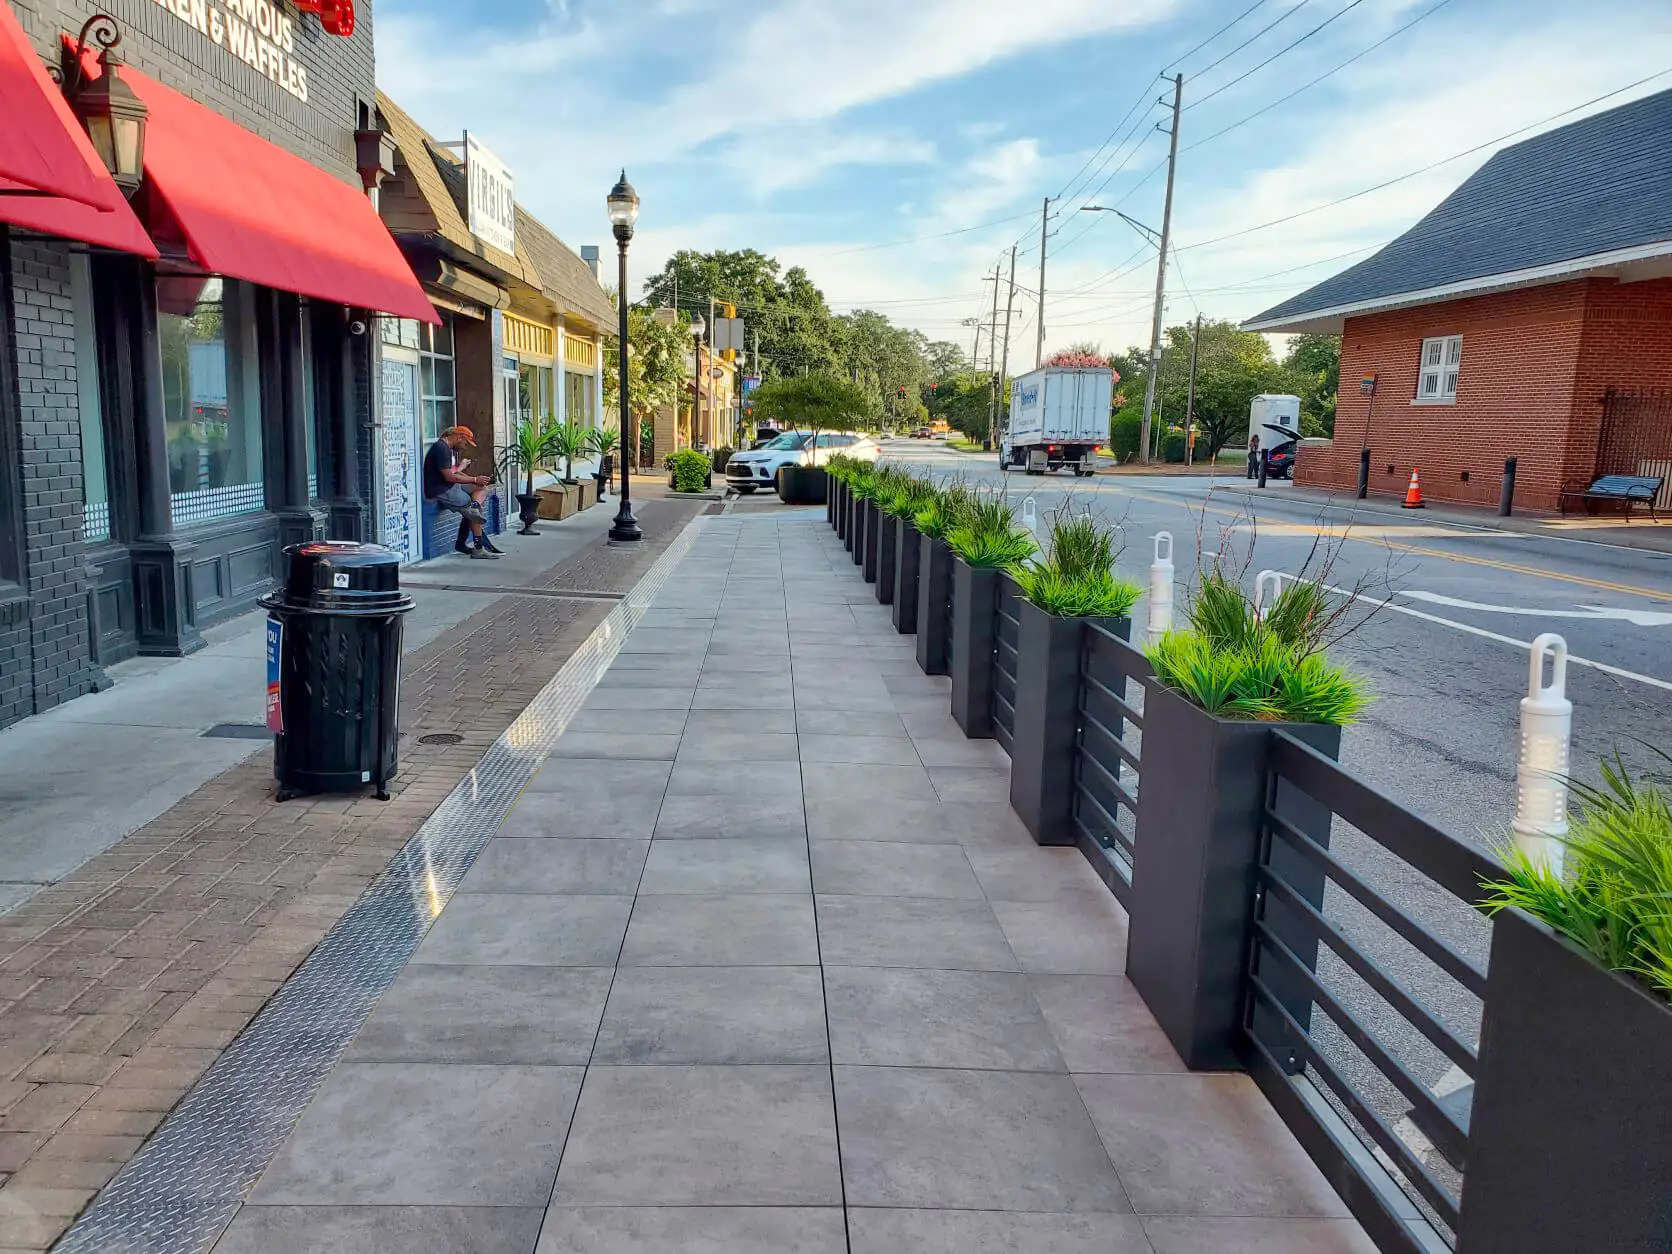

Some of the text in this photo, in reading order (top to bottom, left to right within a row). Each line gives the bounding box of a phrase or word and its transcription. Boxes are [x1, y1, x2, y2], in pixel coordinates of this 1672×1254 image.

[208, 7, 224, 45] &
[225, 12, 308, 102] WAFFLES
[219, 0, 292, 53] MOUS
